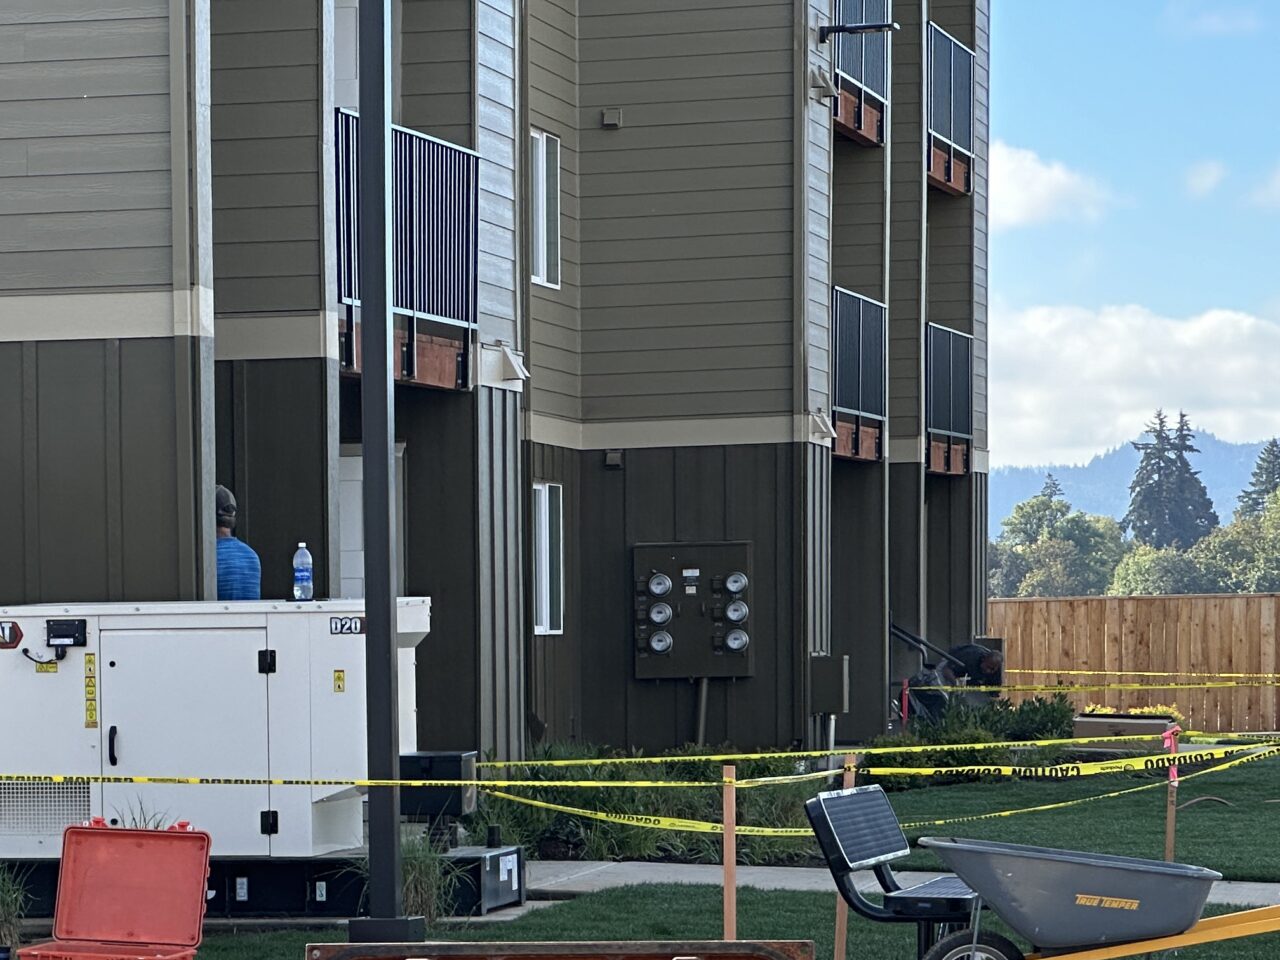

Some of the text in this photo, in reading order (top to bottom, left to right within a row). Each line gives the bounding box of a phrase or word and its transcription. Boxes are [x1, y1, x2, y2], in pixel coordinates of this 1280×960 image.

[330, 617, 361, 634] D20
[1144, 752, 1215, 770] CUIDADO
[1011, 765, 1081, 777] CAUTION
[1075, 894, 1140, 910] TRUE TEMPER
